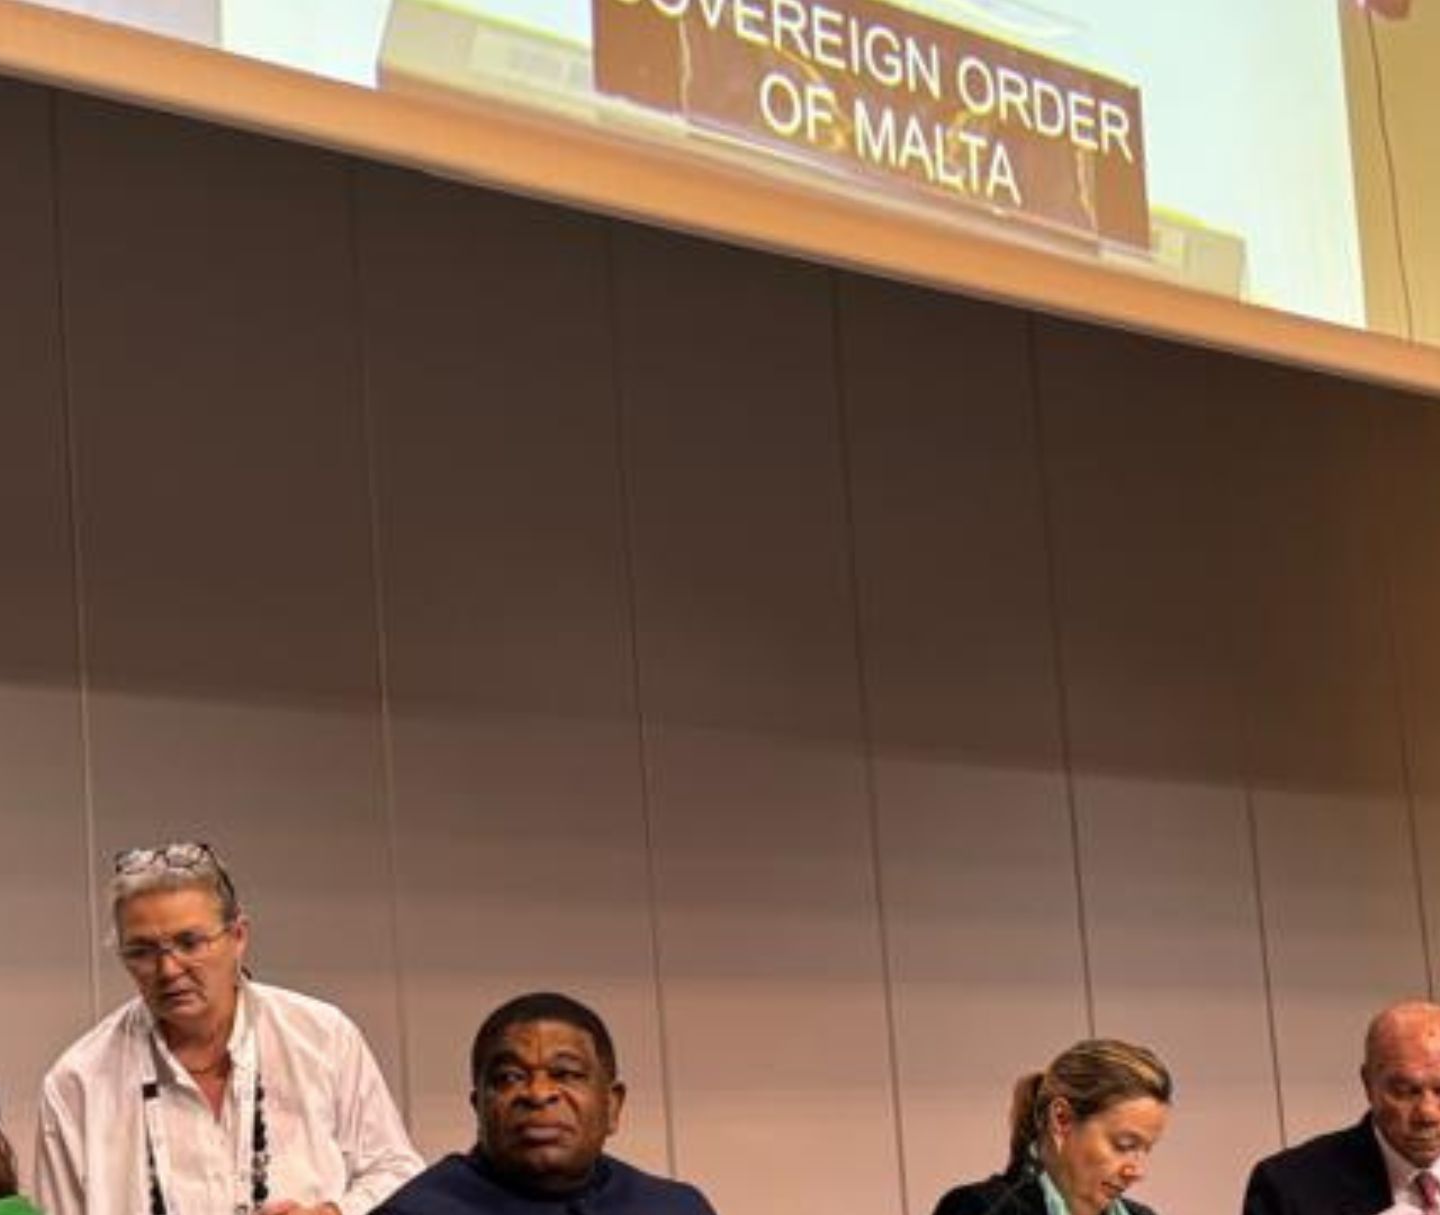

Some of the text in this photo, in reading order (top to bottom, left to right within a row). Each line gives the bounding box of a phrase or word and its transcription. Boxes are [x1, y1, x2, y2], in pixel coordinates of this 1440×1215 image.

[760, 72, 1021, 204] OF MALTA
[958, 57, 1134, 162] ORDER
